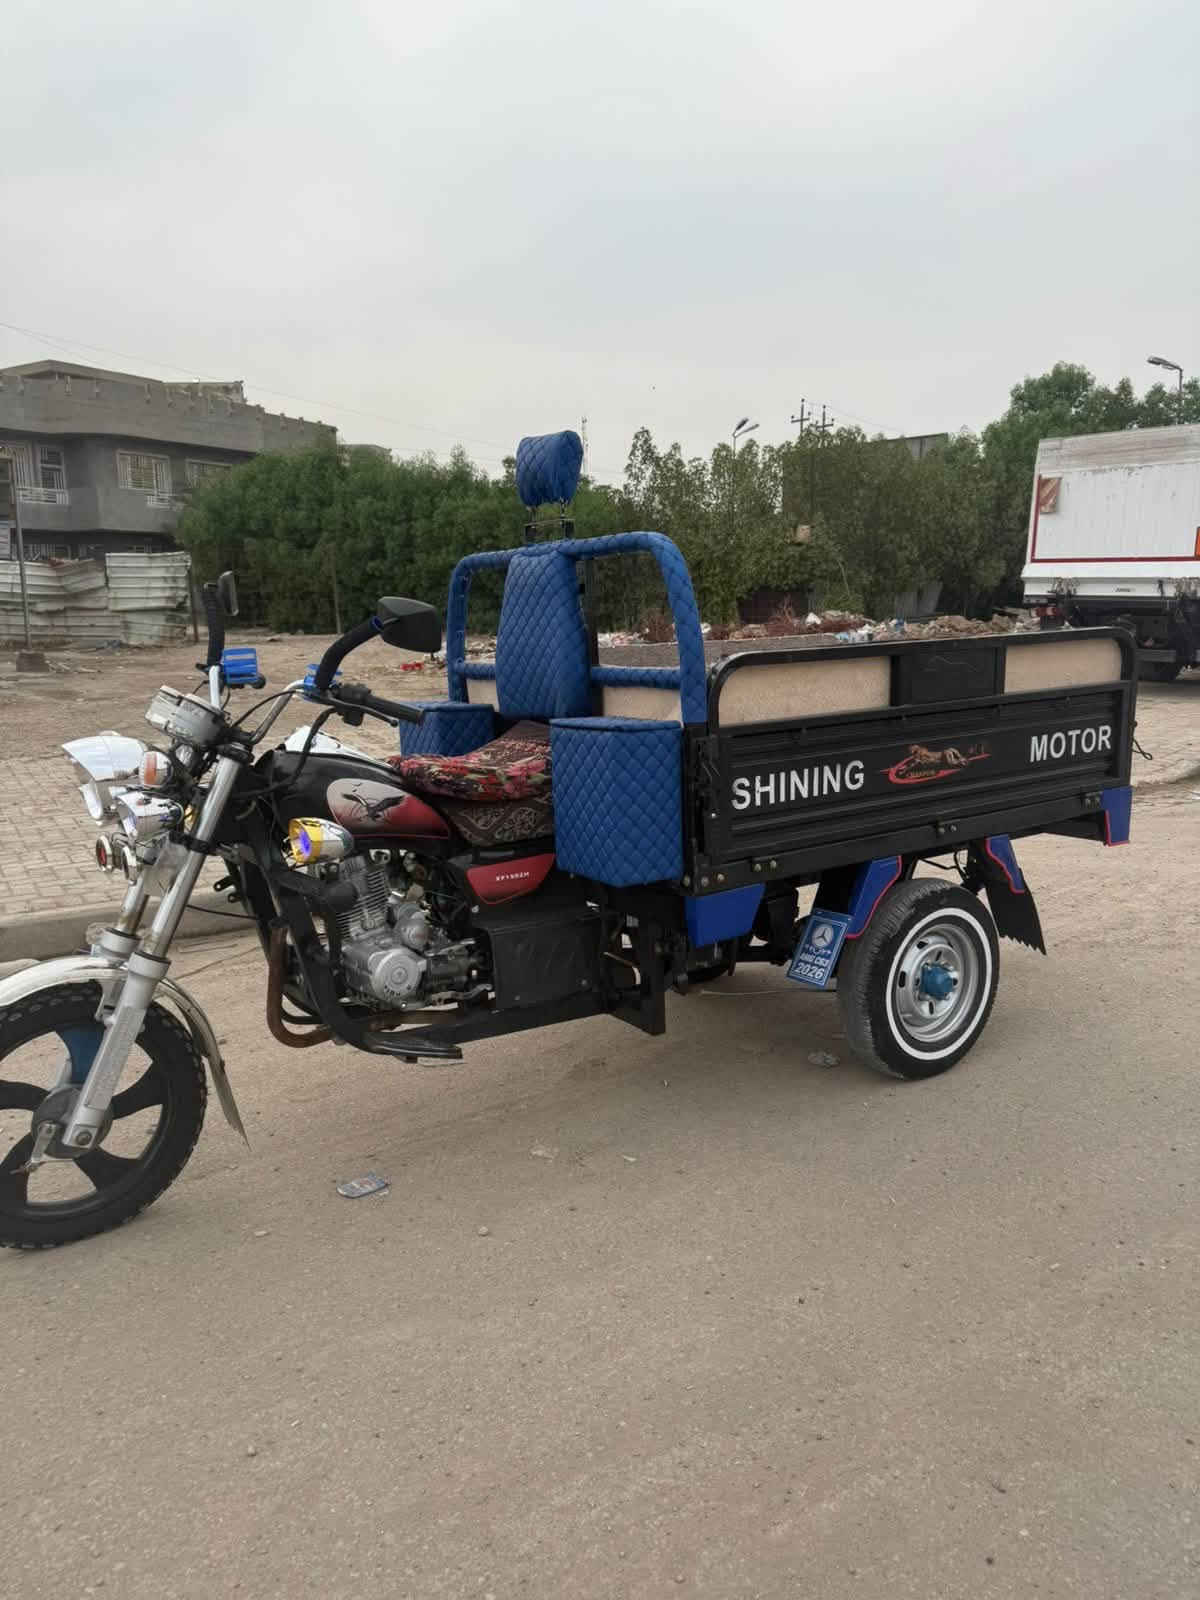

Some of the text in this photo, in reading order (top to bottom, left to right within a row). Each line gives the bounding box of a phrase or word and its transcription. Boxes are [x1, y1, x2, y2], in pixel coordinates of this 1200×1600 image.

[1030, 725, 1112, 763] MOTOR
[731, 760, 865, 810] SHINING
[794, 962, 825, 979] 2026
